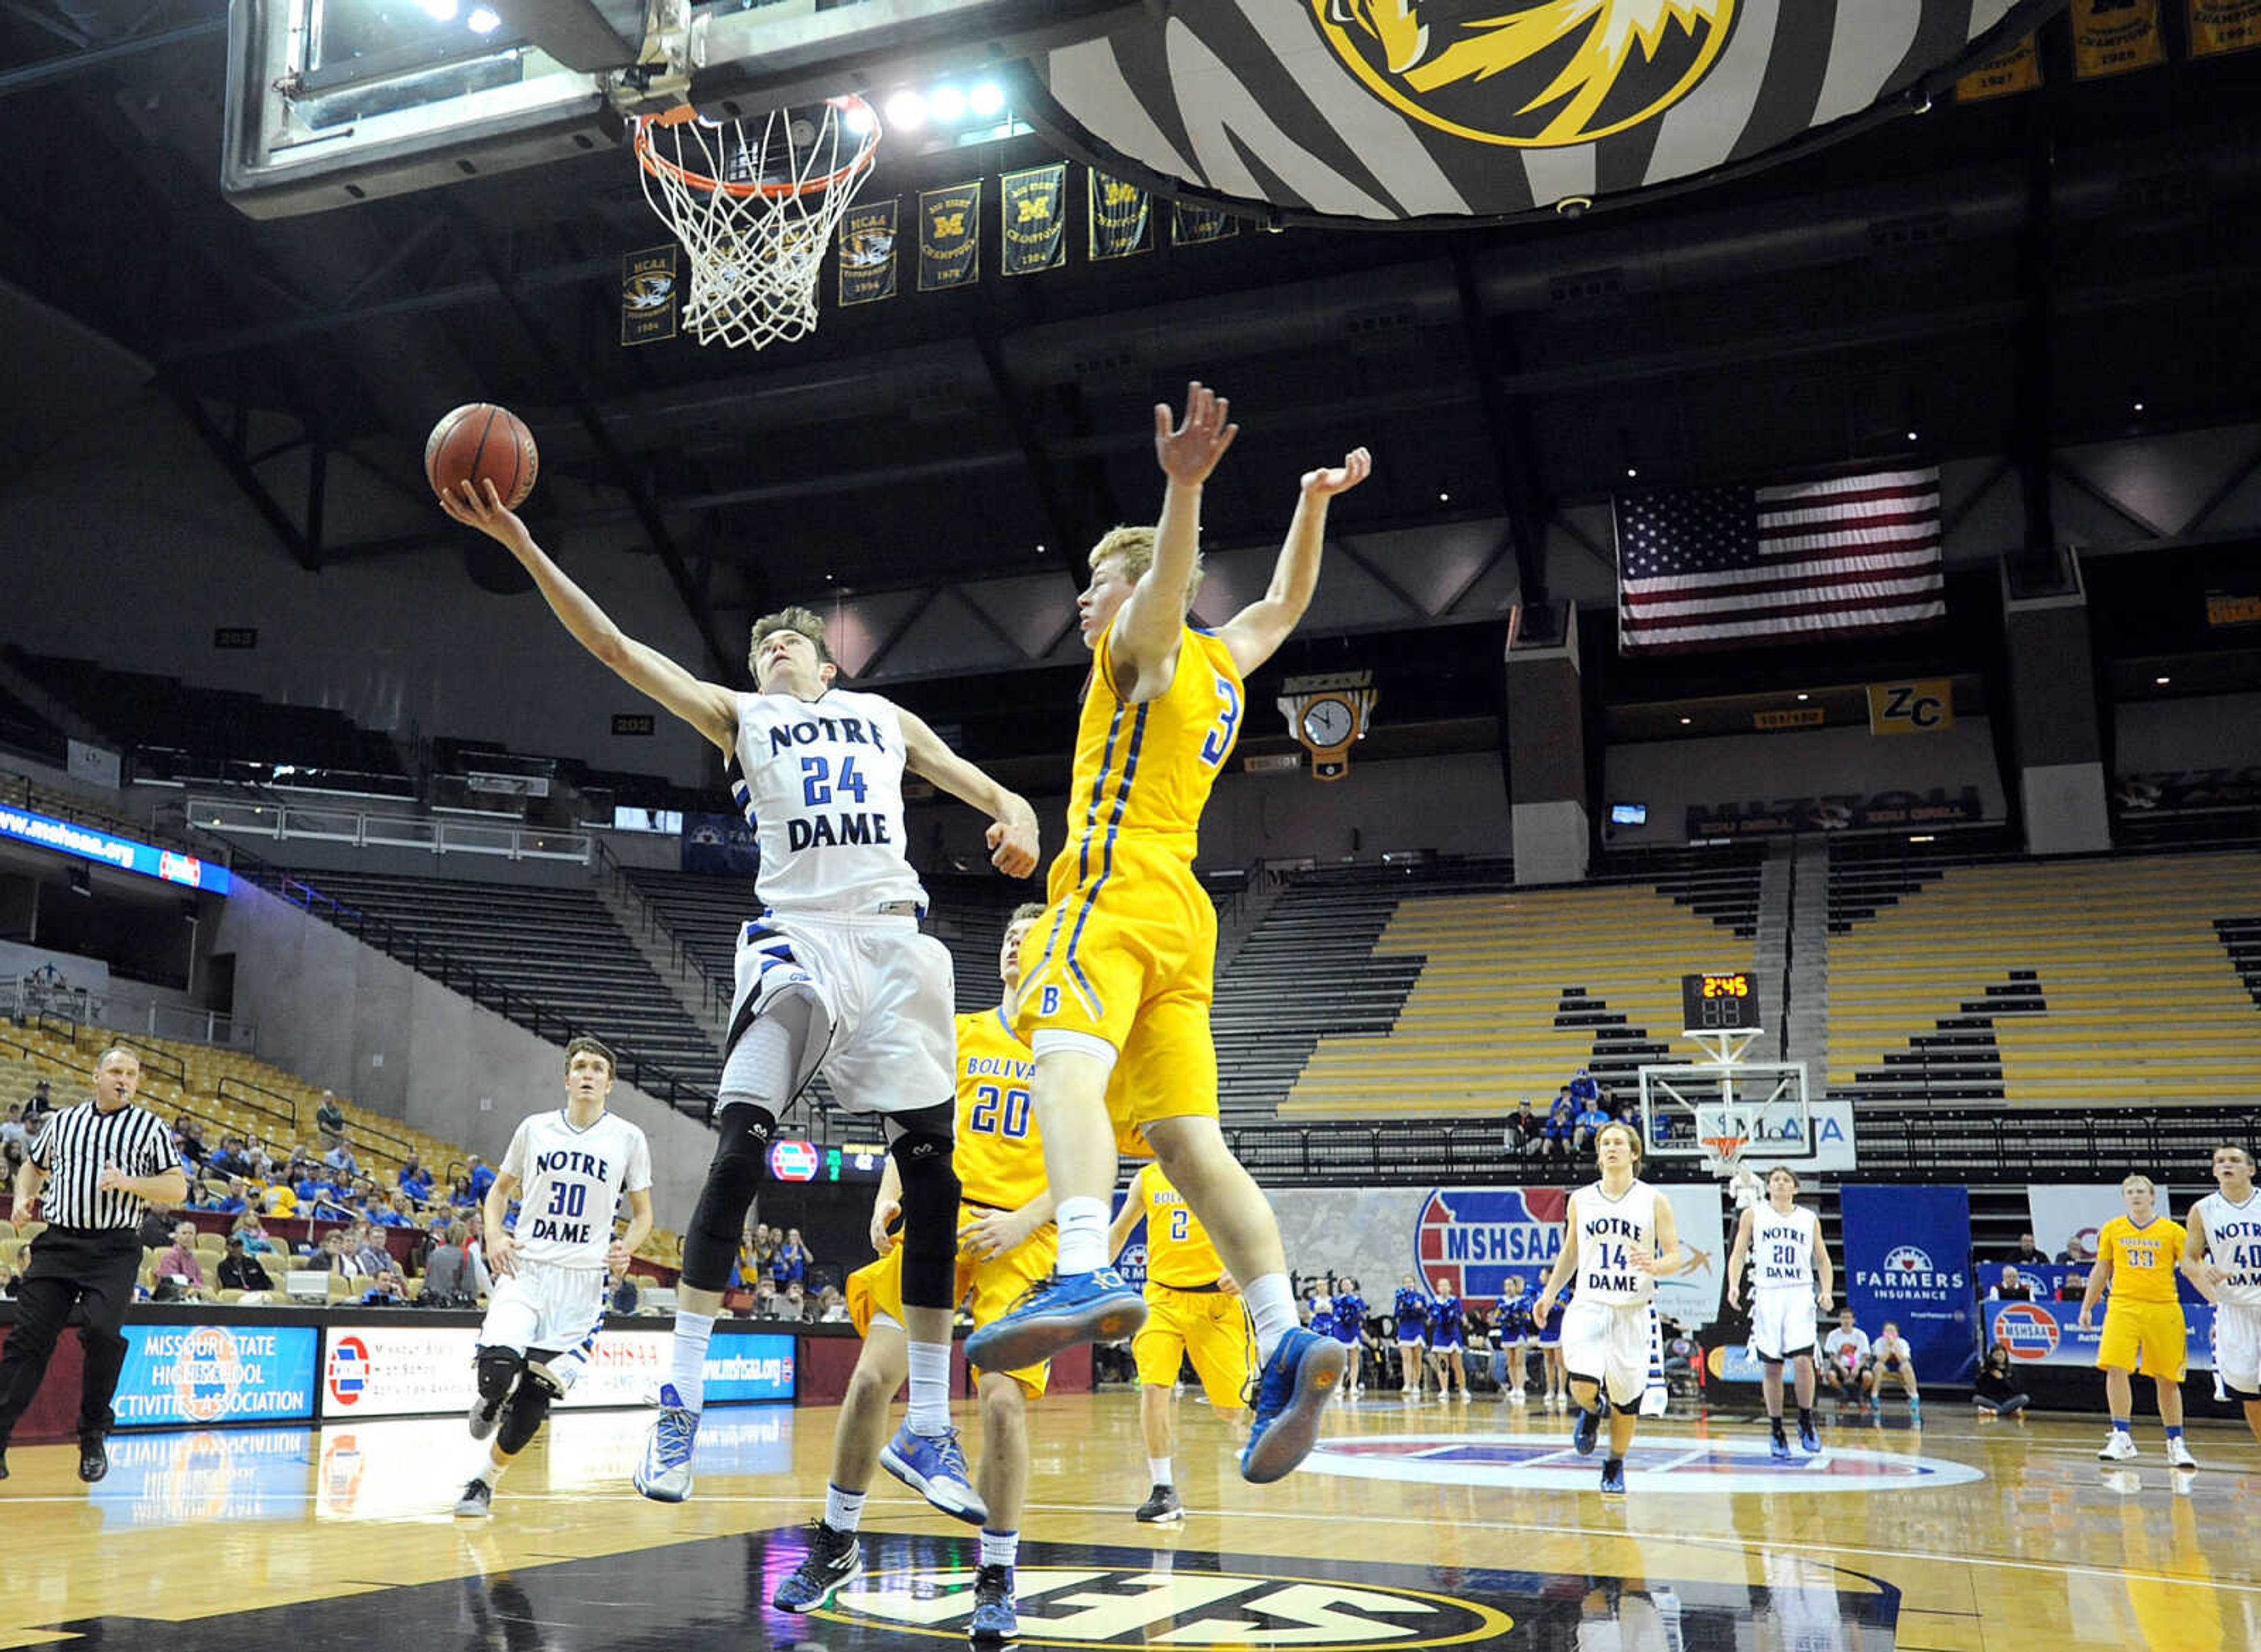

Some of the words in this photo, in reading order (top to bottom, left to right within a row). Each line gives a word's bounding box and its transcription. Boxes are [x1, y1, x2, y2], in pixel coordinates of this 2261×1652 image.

[1017, 195, 1049, 223] M
[851, 215, 886, 231] NCAA
[933, 213, 964, 238] M
[1883, 688, 1941, 728] ZC
[1199, 675, 1242, 768] 3
[801, 756, 868, 806] 24
[787, 812, 891, 852] DAME
[1702, 976, 1748, 998] 2:45
[1039, 985, 1060, 1016] B
[972, 1086, 1030, 1137] 20
[536, 1151, 608, 1182] NOTRE
[548, 1180, 586, 1217] 30
[532, 1219, 591, 1244] DAME
[1171, 1210, 1188, 1240] 2
[1586, 1217, 1642, 1243] NOTRE
[1447, 1227, 1561, 1260] MSHSAA
[1600, 1243, 1627, 1270] 14
[1772, 1245, 1795, 1265] 20
[2127, 1248, 2154, 1268] 33
[1589, 1273, 1638, 1292] DAME
[1856, 1271, 1964, 1288] FARMERS
[1874, 1289, 1947, 1301] INSURANCE
[144, 1335, 224, 1356] MISSOURI
[229, 1335, 277, 1356] STATE
[114, 1394, 197, 1417] CTIVITIES
[200, 1391, 304, 1415] ASSOCIATION
